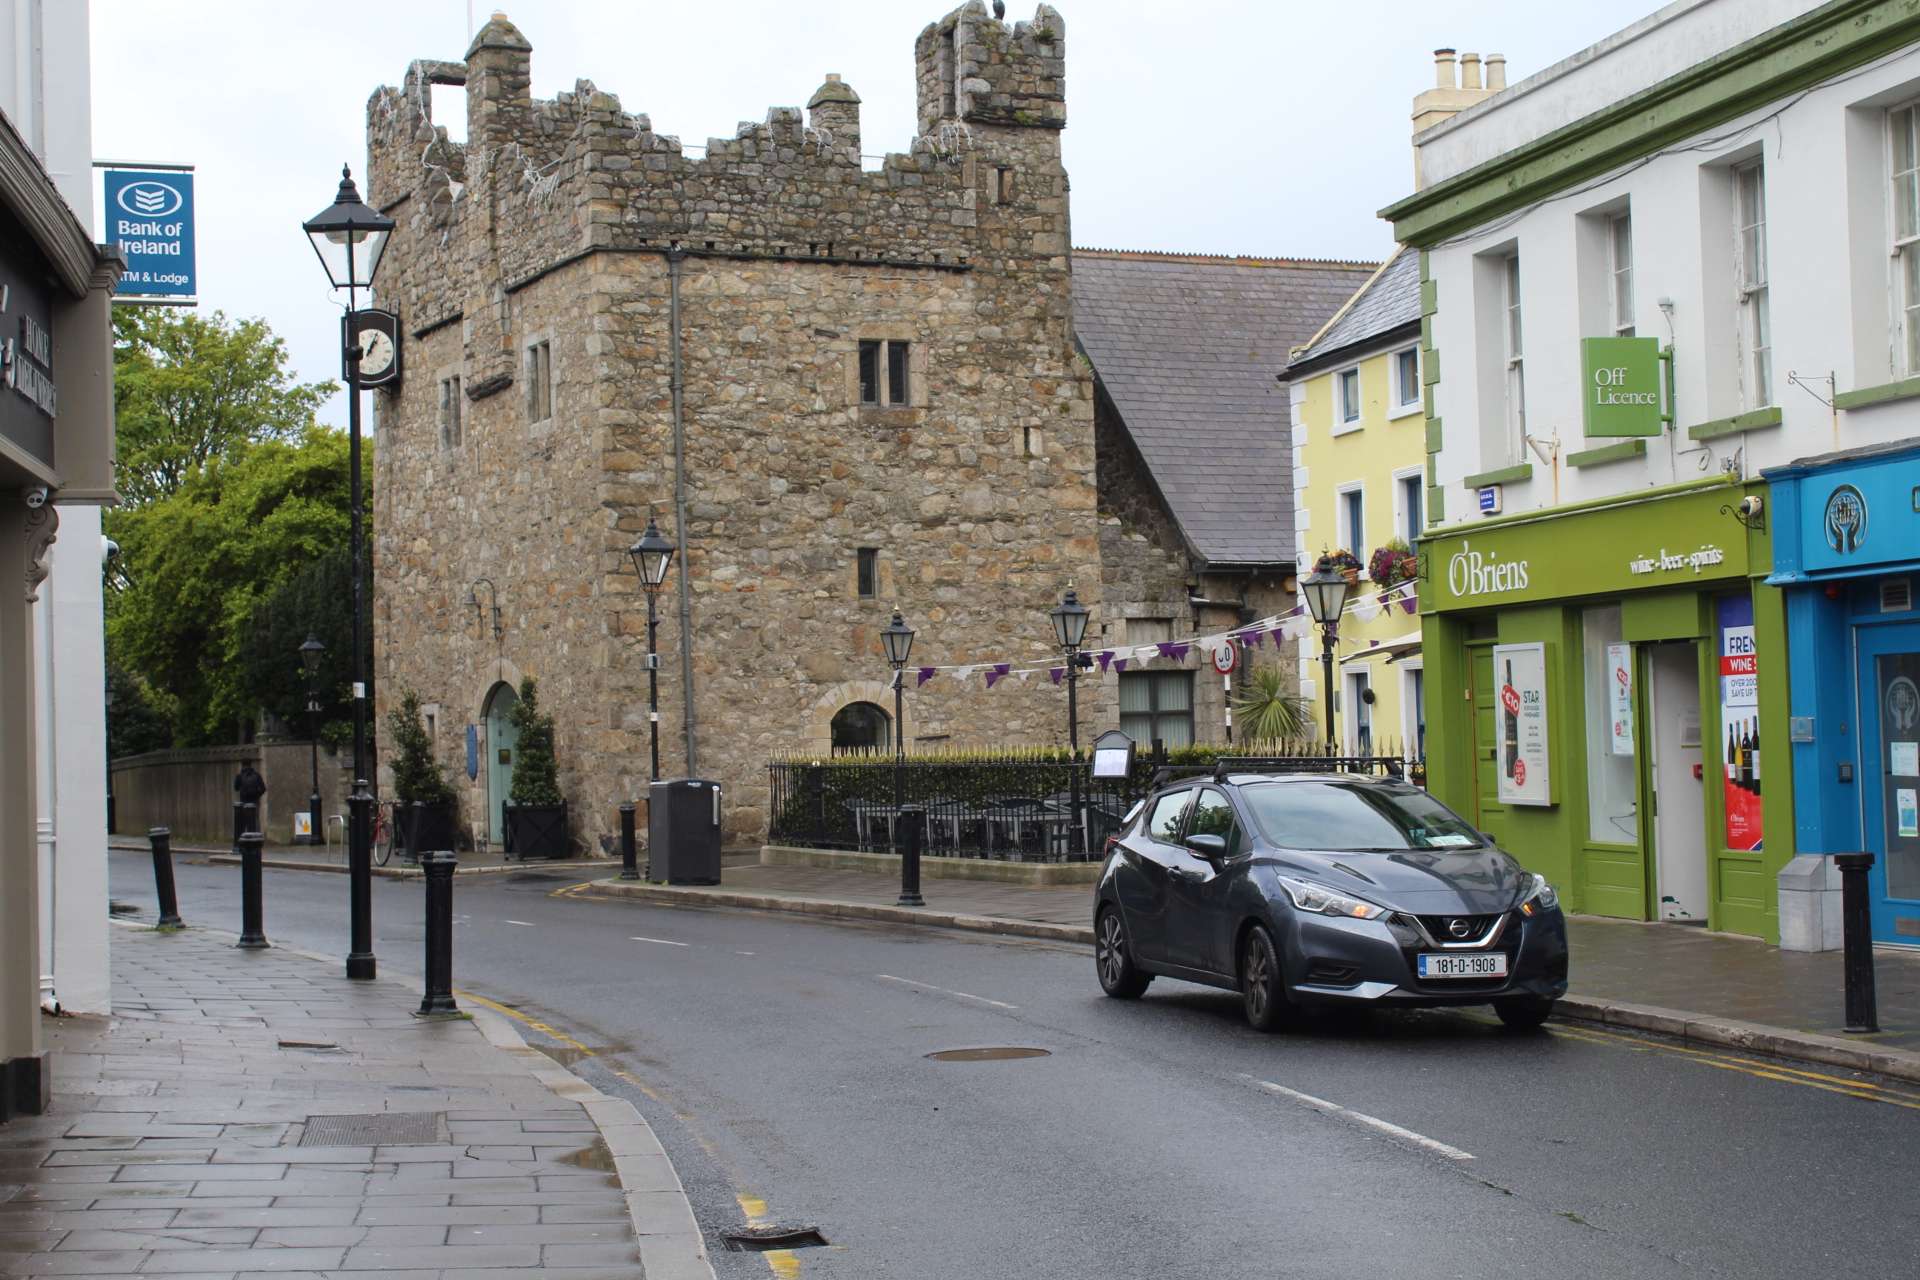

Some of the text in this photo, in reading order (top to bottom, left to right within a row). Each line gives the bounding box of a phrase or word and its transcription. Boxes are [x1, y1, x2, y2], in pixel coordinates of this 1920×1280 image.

[118, 220, 184, 237] Bank of
[119, 238, 181, 256] Ireland
[120, 271, 189, 286] TM & Lodge
[1594, 366, 1628, 386] Off
[1595, 386, 1657, 405] Licence
[1448, 540, 1529, 597] O'Briens
[1729, 657, 1752, 671] WINE
[1730, 679, 1745, 688] OVER
[1523, 690, 1540, 703] STAR
[1731, 688, 1745, 698] SAVE
[1745, 688, 1754, 697] UP
[1505, 692, 1519, 711] €10
[1436, 958, 1496, 973] 181-D-1908
